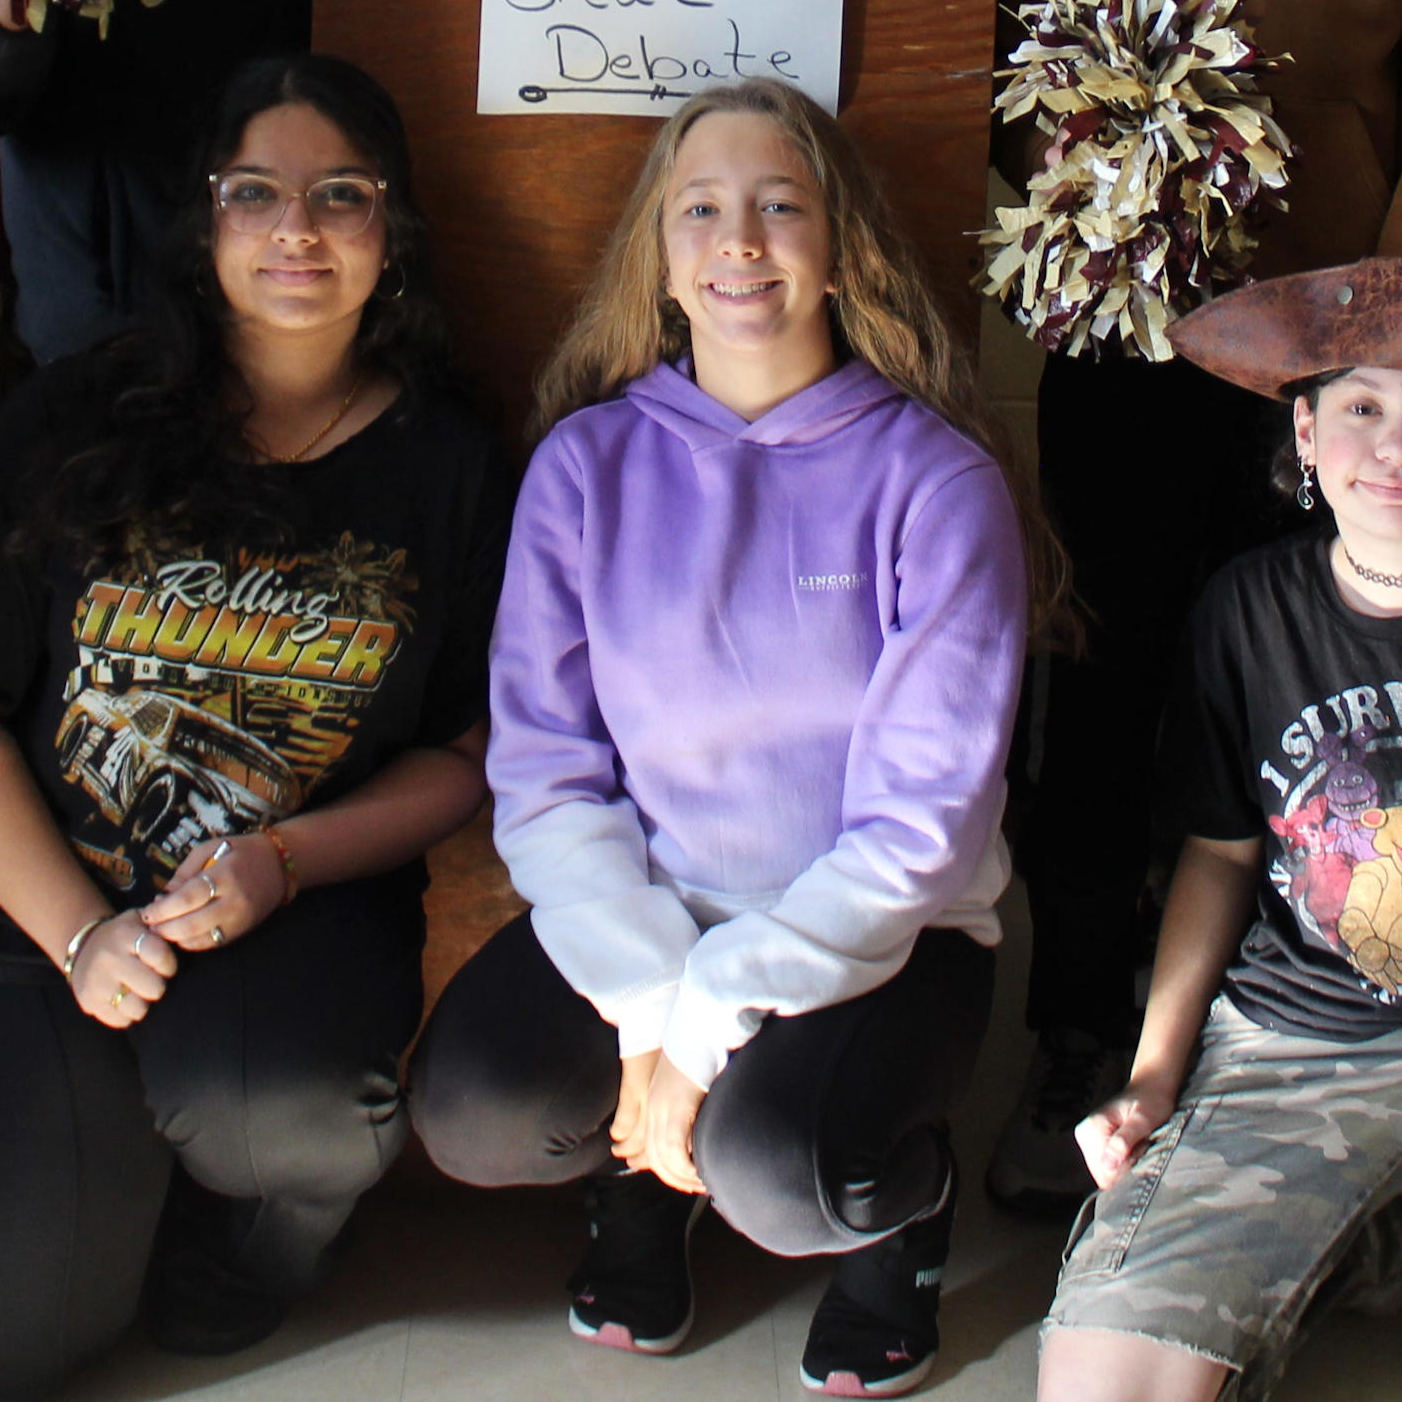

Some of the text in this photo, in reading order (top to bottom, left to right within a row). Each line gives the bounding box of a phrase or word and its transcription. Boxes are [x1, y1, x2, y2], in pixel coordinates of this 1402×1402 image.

[545, 17, 800, 83] Debate
[77, 581, 401, 690] THUNDER
[155, 559, 341, 644] Rolling
